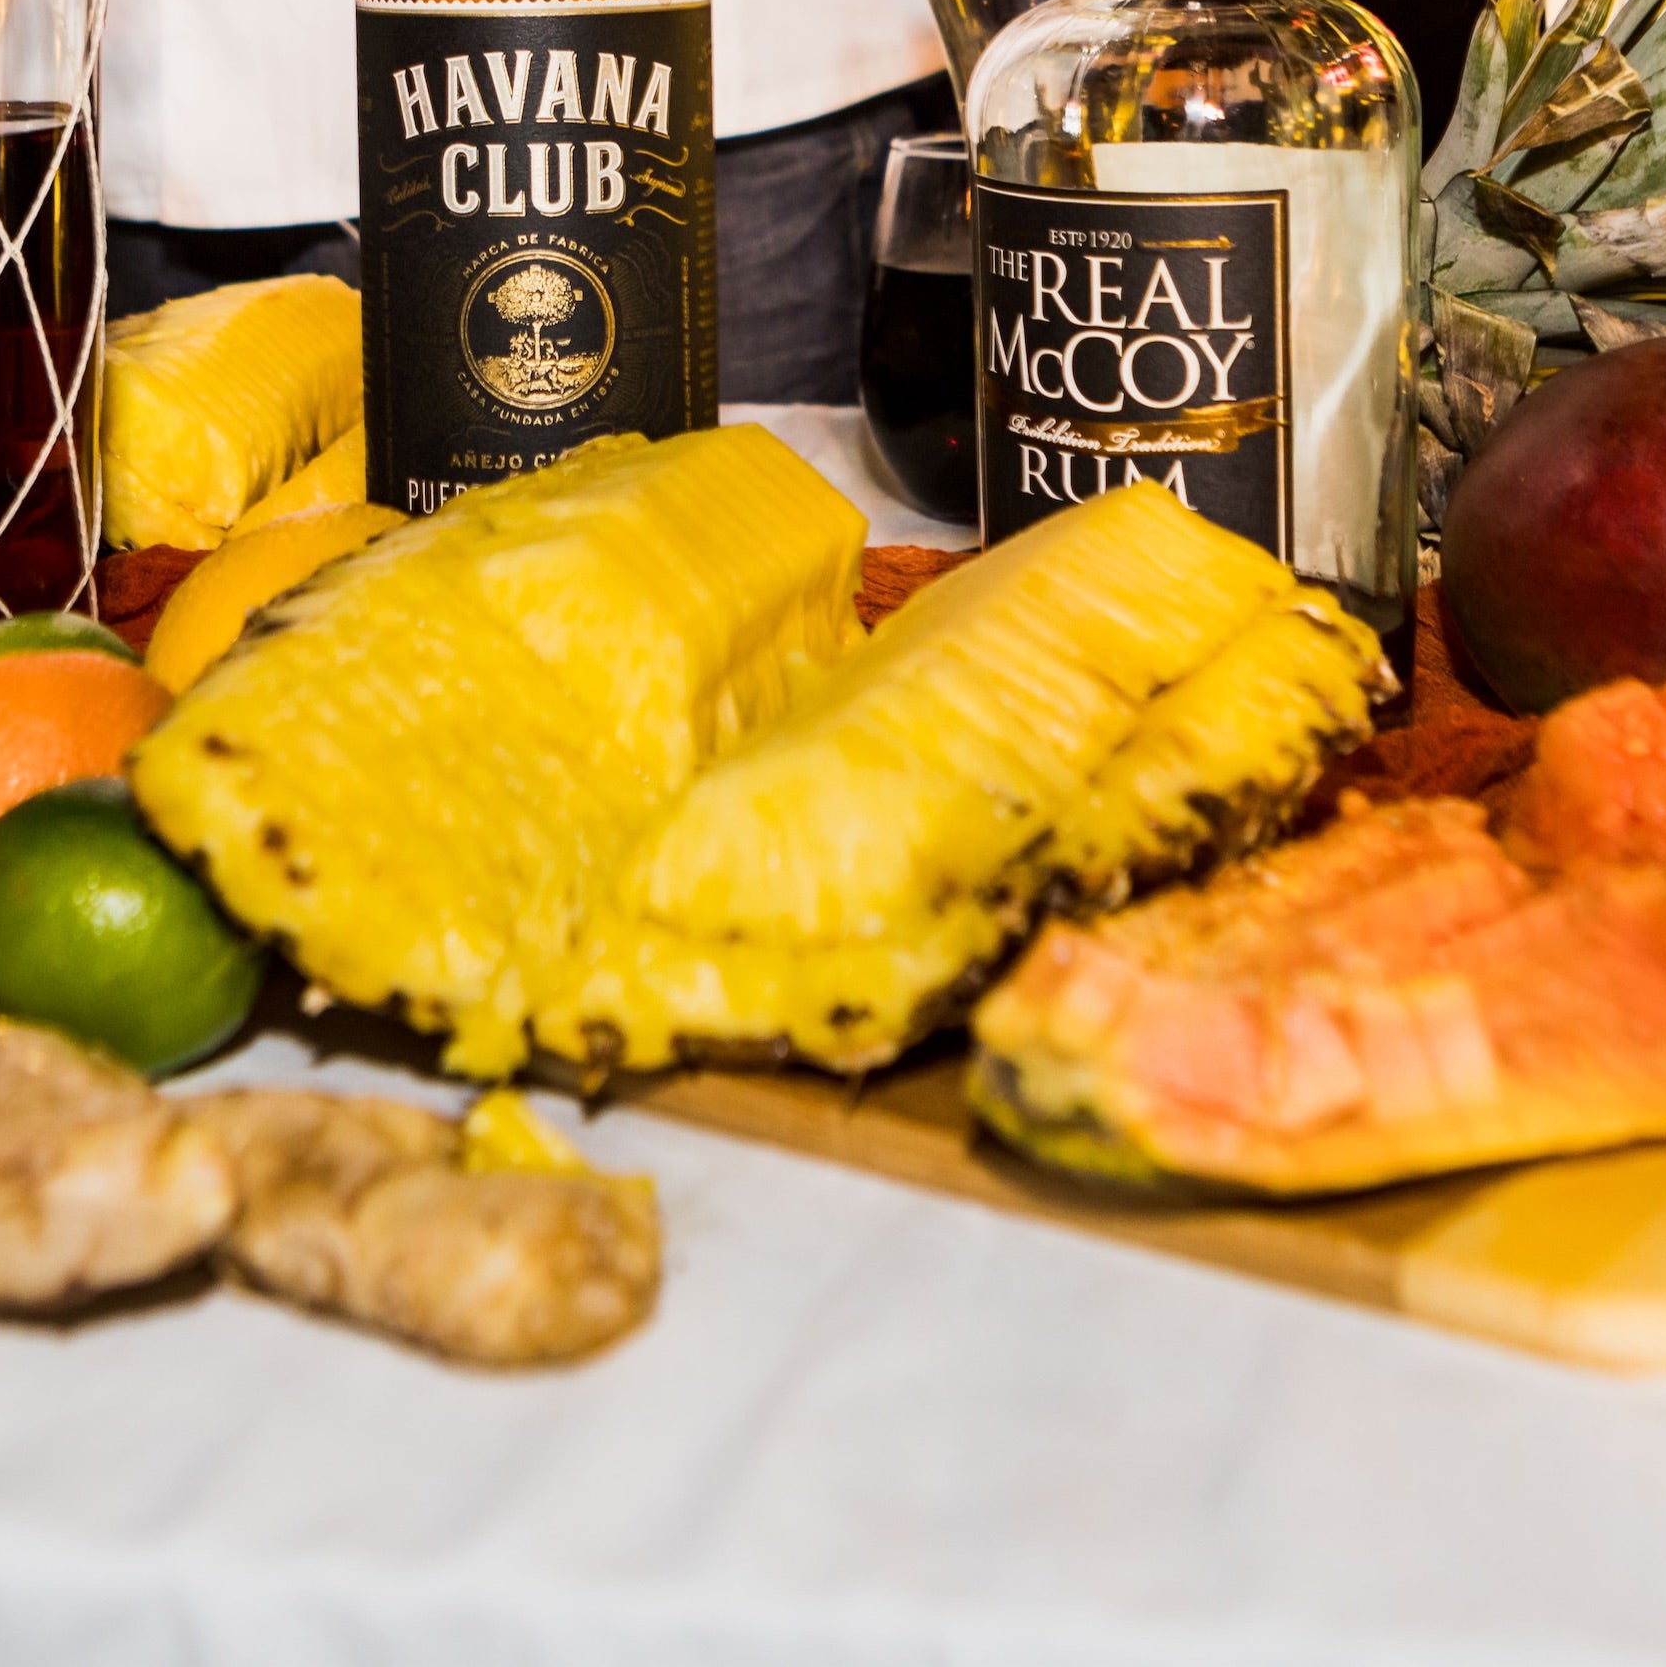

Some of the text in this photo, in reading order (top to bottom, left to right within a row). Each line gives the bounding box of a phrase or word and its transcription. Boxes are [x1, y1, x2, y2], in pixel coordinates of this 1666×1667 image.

[393, 50, 672, 140] HAVANA
[442, 141, 626, 217] CLUB
[462, 240, 510, 279] MARCA
[517, 234, 539, 246] DE
[1090, 230, 1132, 250] 1920
[988, 245, 1253, 330] THE REAL
[457, 367, 620, 426] CASA FUNDADA EN 1878
[449, 449, 523, 469] AÑEJO
[1007, 414, 1221, 453] Prohibition Tradition
[1018, 443, 1198, 512] RUM
